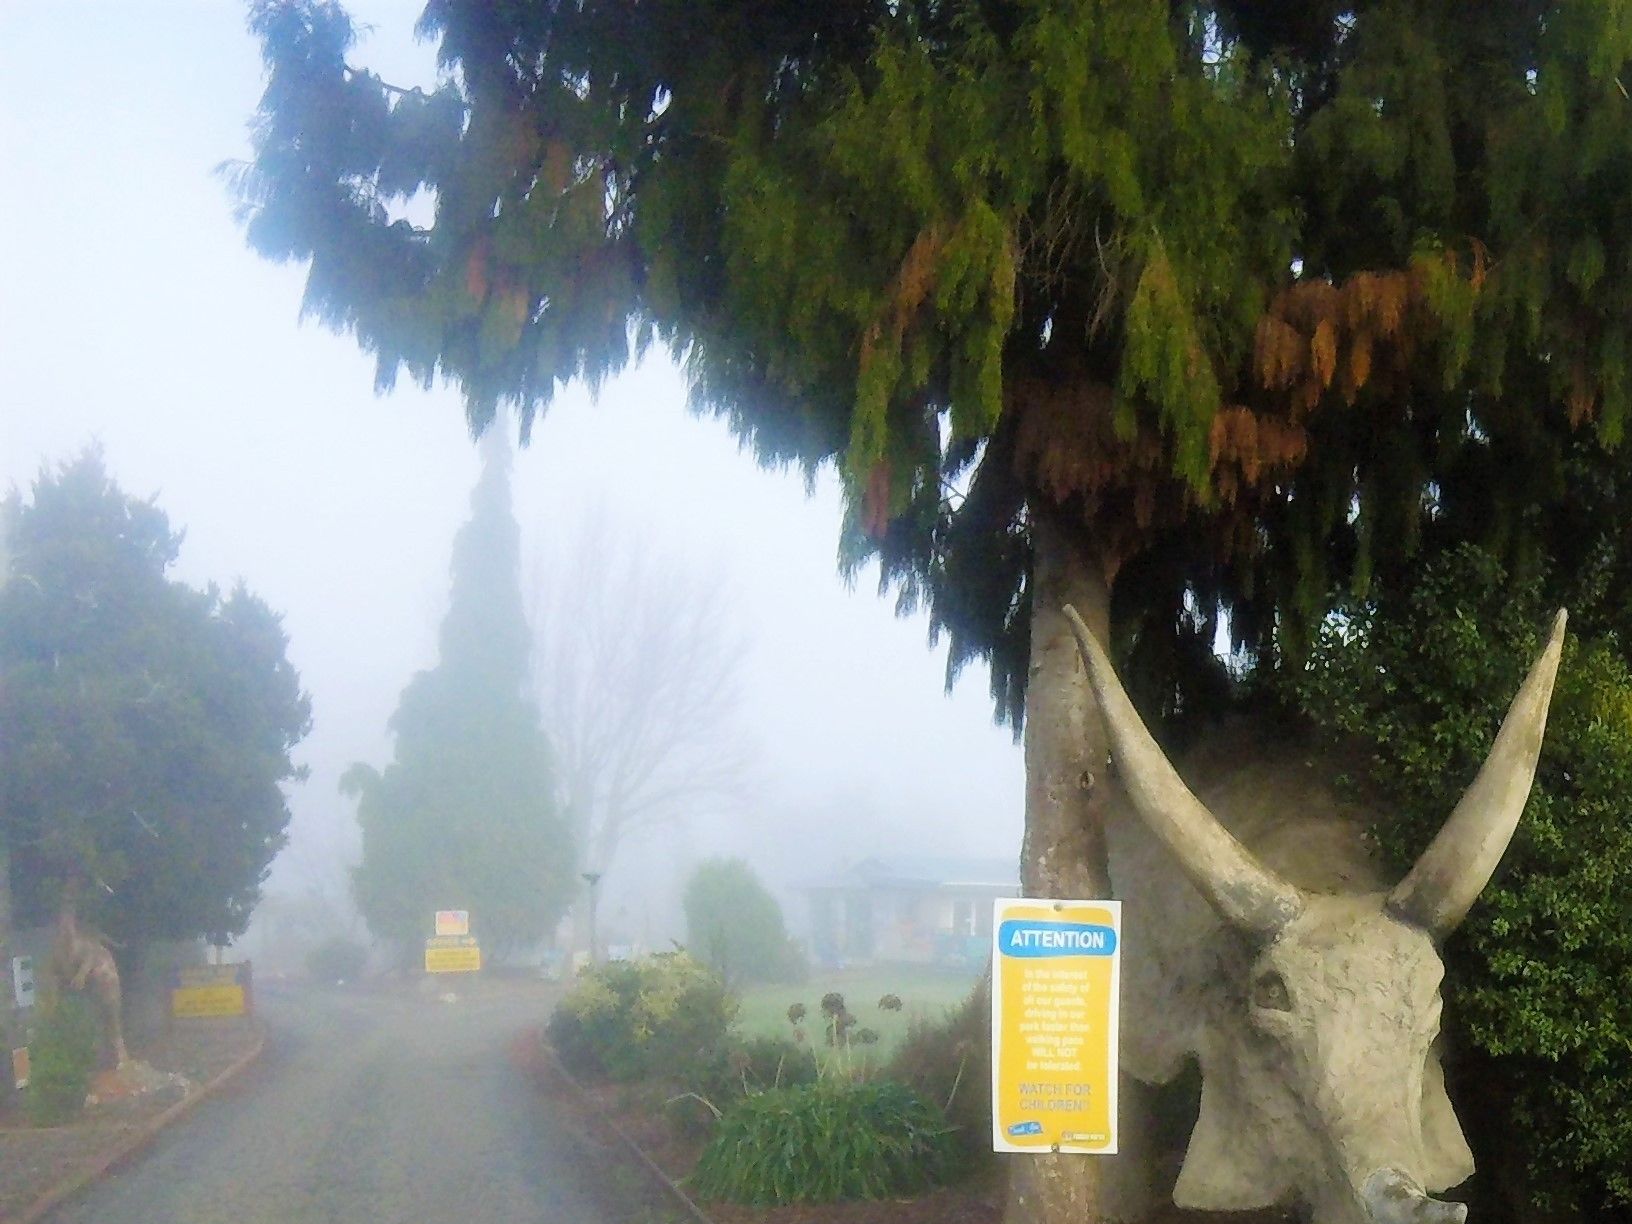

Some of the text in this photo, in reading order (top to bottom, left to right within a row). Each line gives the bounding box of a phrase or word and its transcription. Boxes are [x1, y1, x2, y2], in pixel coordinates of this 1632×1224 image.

[1009, 929, 1105, 949] ATTENTION
[1019, 1083, 1092, 1096] WATCH FOR
